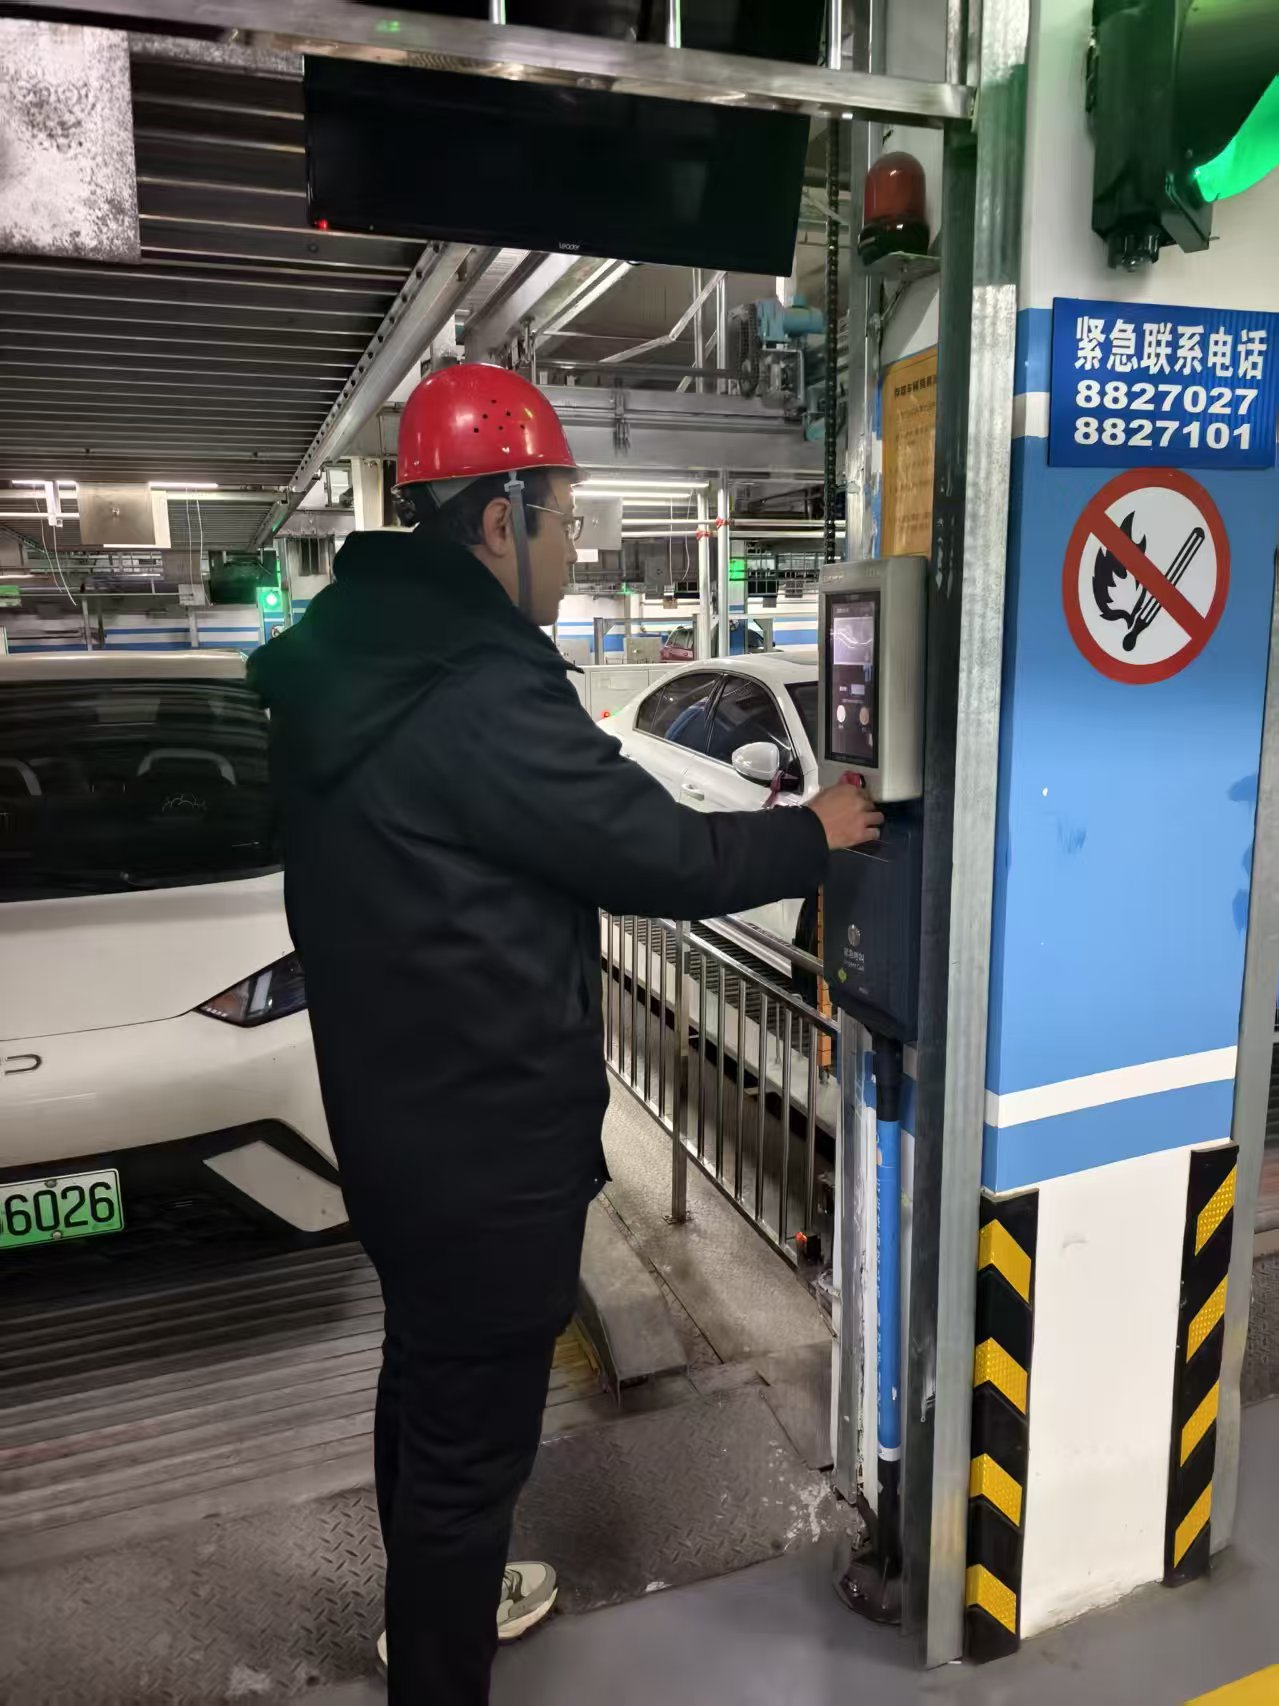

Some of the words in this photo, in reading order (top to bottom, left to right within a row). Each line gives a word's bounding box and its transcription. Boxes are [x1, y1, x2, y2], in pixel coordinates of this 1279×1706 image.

[1074, 316, 1268, 380] 紧急联系电话
[1075, 379, 1259, 415] 8827027
[1074, 416, 1251, 450] 8827101
[0, 1181, 115, 1236] 6026
